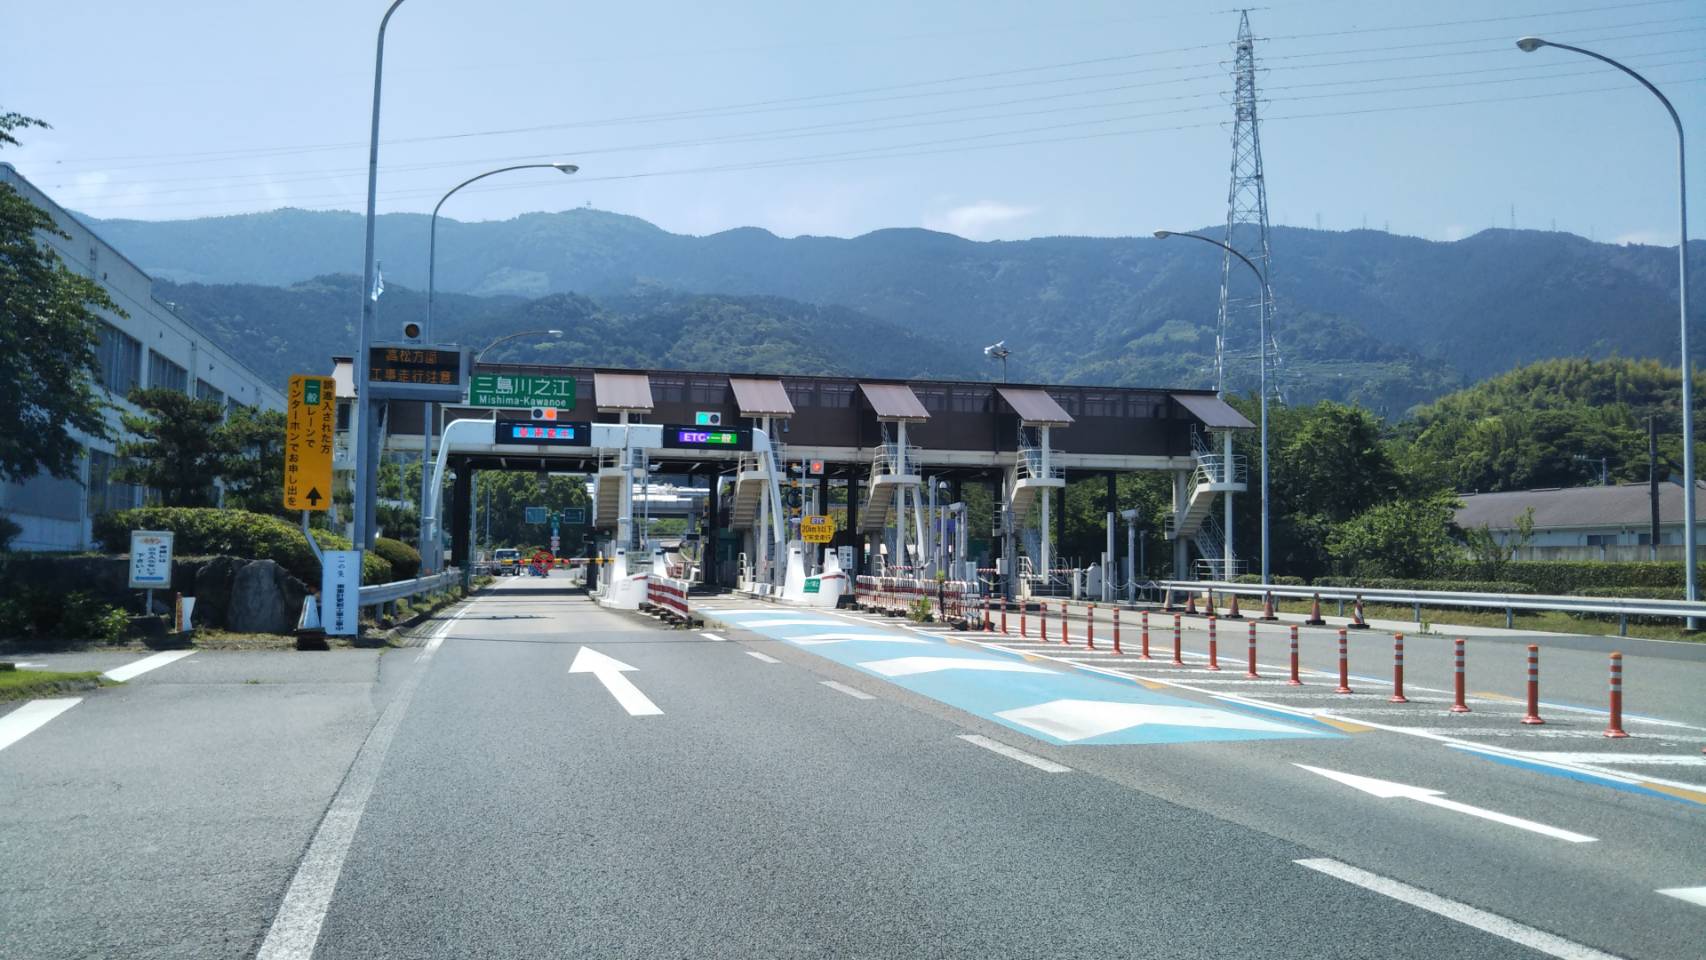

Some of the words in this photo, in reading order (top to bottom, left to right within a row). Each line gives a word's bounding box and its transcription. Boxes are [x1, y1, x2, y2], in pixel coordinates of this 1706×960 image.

[476, 376, 570, 396] 三島川之江
[479, 395, 567, 407] Mishima-Kawanoe
[320, 380, 334, 454] 誤進入された方
